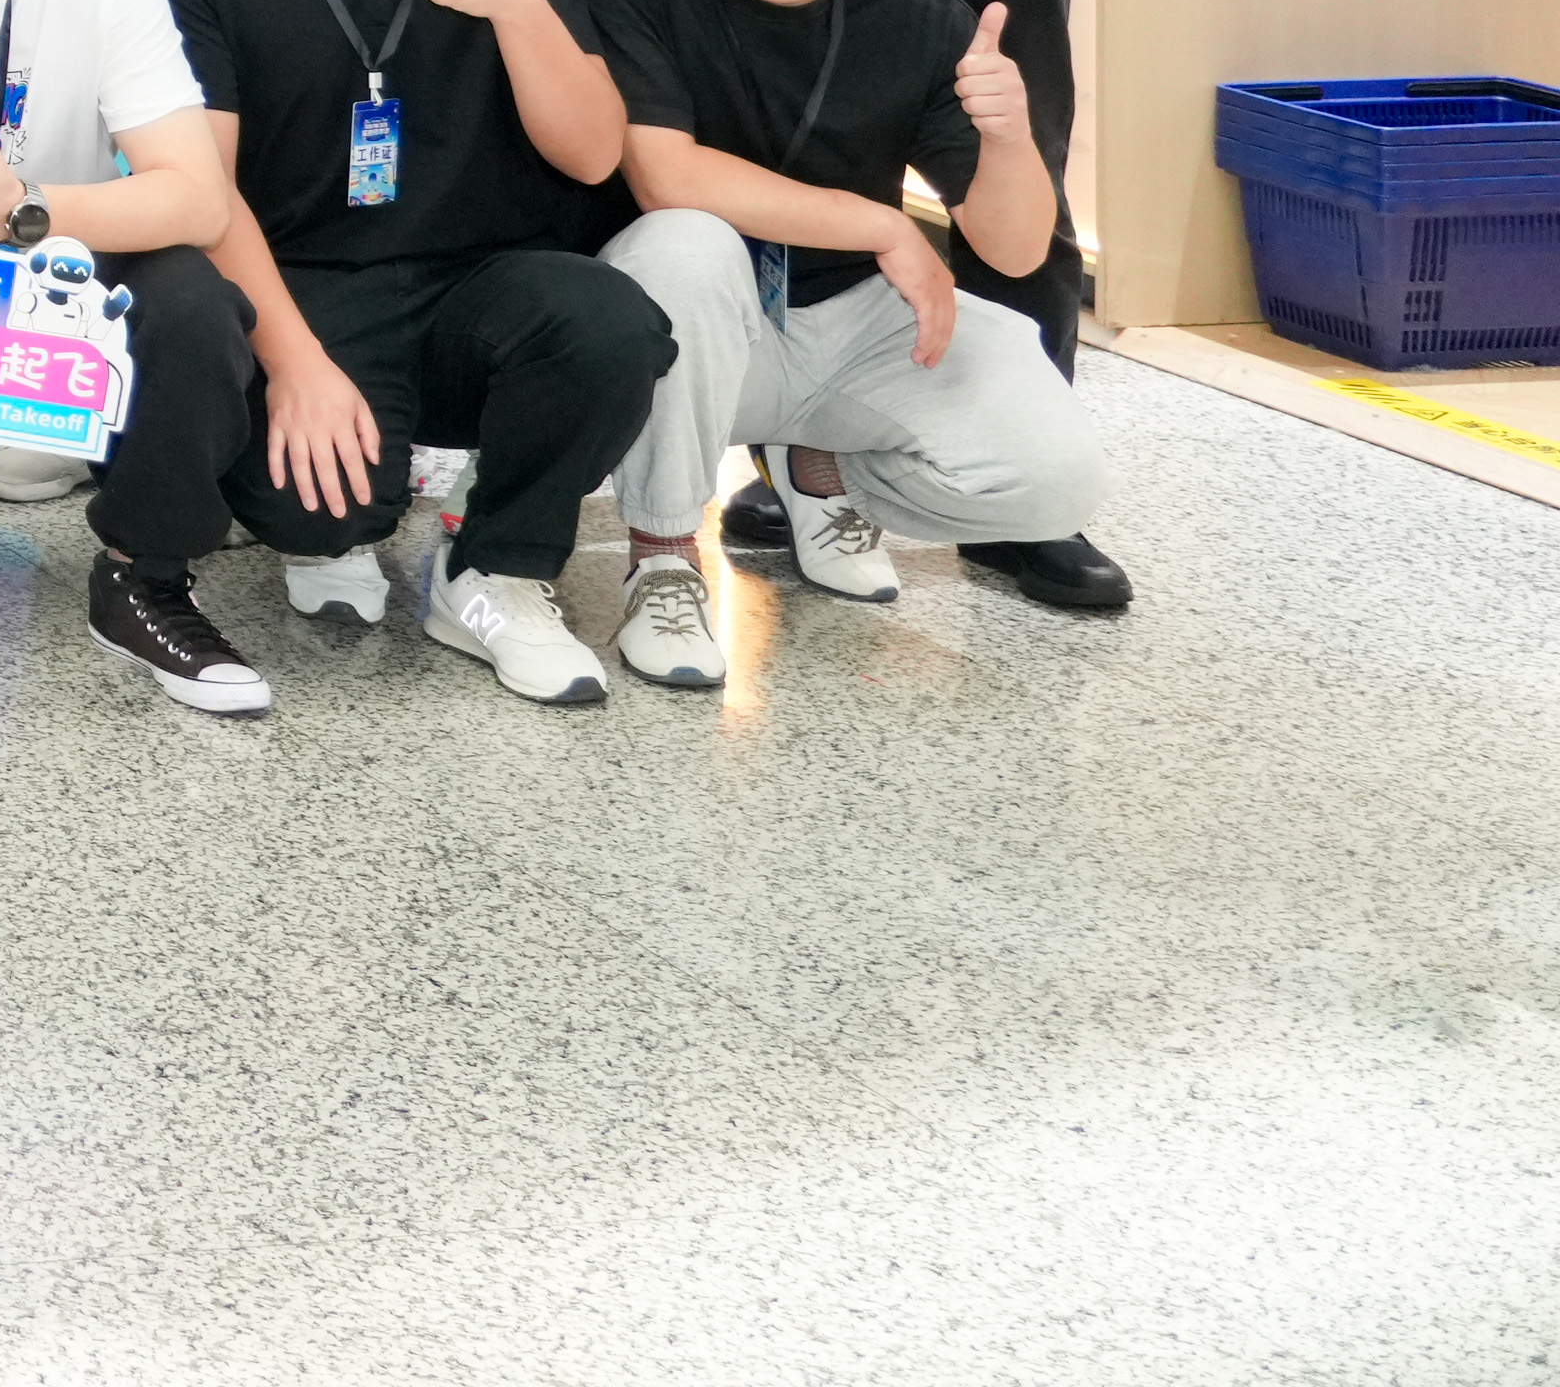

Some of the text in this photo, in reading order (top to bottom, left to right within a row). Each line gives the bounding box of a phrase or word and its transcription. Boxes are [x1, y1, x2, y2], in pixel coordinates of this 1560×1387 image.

[357, 146, 392, 161] 工作证
[1, 402, 94, 430] Takeoff
